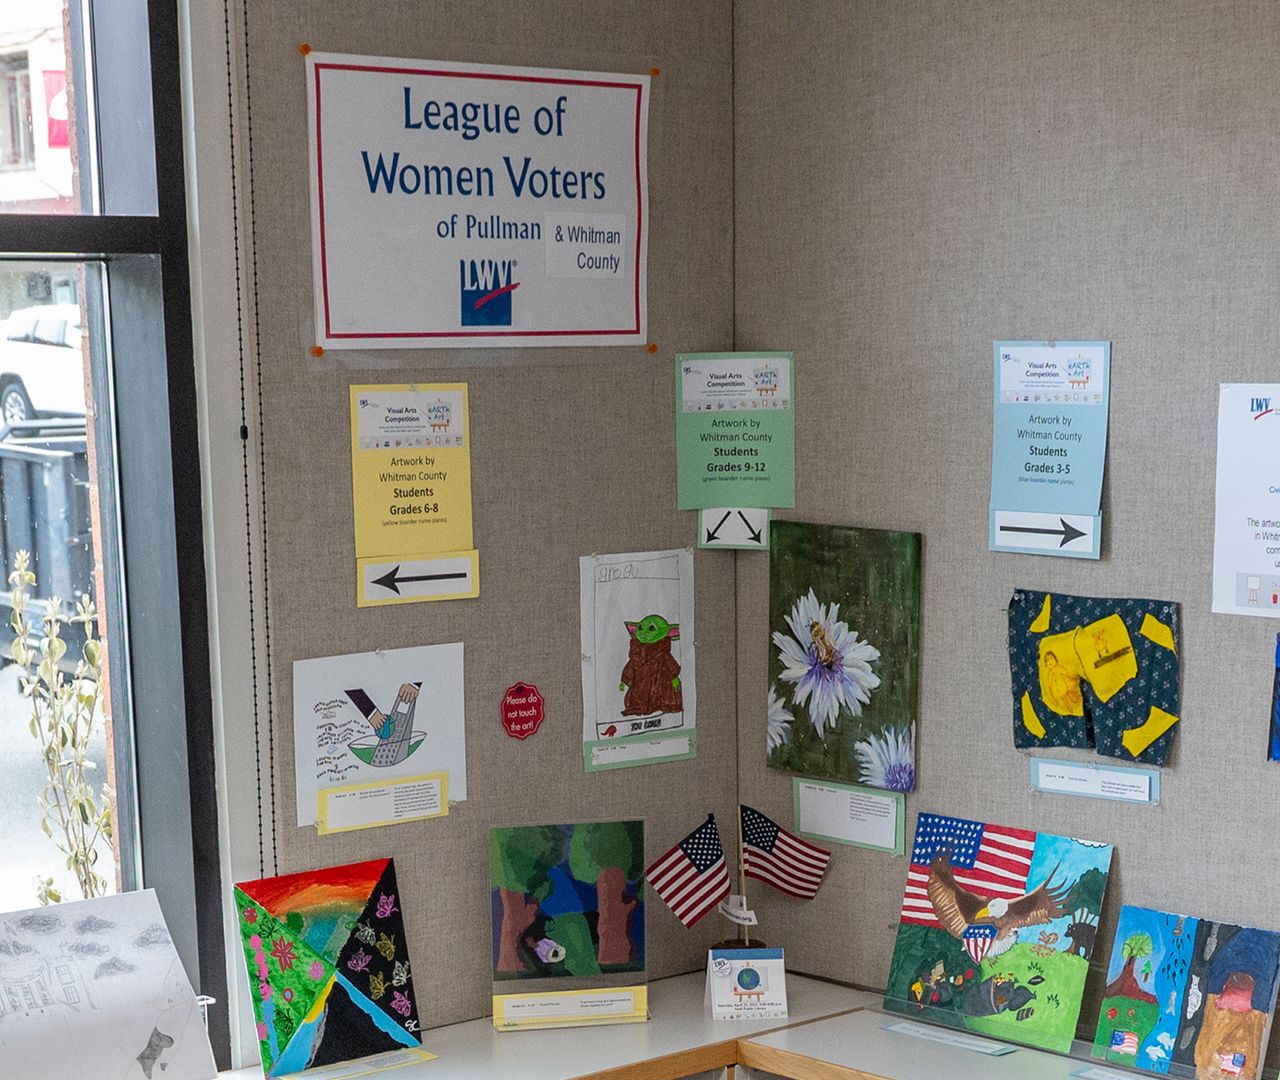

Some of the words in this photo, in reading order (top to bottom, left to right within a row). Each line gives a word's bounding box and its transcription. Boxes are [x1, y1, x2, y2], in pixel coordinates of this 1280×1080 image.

[403, 86, 520, 141] League
[533, 96, 567, 137] of
[361, 150, 494, 197] Women
[503, 156, 606, 200] Voters
[436, 214, 458, 239] of
[465, 214, 542, 241] Pullman
[554, 226, 564, 243] &
[567, 225, 621, 244] Whitman
[577, 251, 621, 274] County
[711, 419, 748, 428] Artwork
[750, 419, 761, 429] by
[1028, 415, 1060, 425] Artwork
[1062, 415, 1072, 426] by
[700, 433, 740, 442] Whitman
[742, 433, 773, 443] County
[1017, 429, 1053, 440] Whitman
[1054, 431, 1082, 443] County
[714, 447, 758, 457] Students
[1029, 445, 1068, 457] Students
[390, 456, 423, 466] Artwork
[425, 456, 435, 466] by
[707, 462, 742, 472] Grades
[744, 462, 766, 472] 9-12
[1024, 462, 1055, 473] Grades
[1057, 464, 1071, 474] 3-5
[379, 472, 416, 483] Whitman
[418, 472, 447, 482] County
[393, 487, 434, 498] Students
[390, 504, 422, 515] Grades
[424, 503, 439, 513] 6-8
[1247, 518, 1260, 527] The
[1255, 532, 1260, 540] in
[506, 695, 526, 705] Please
[527, 693, 538, 703] do
[507, 709, 518, 719] not
[519, 707, 536, 717] touch
[510, 721, 521, 731] the
[522, 721, 534, 730] art!
